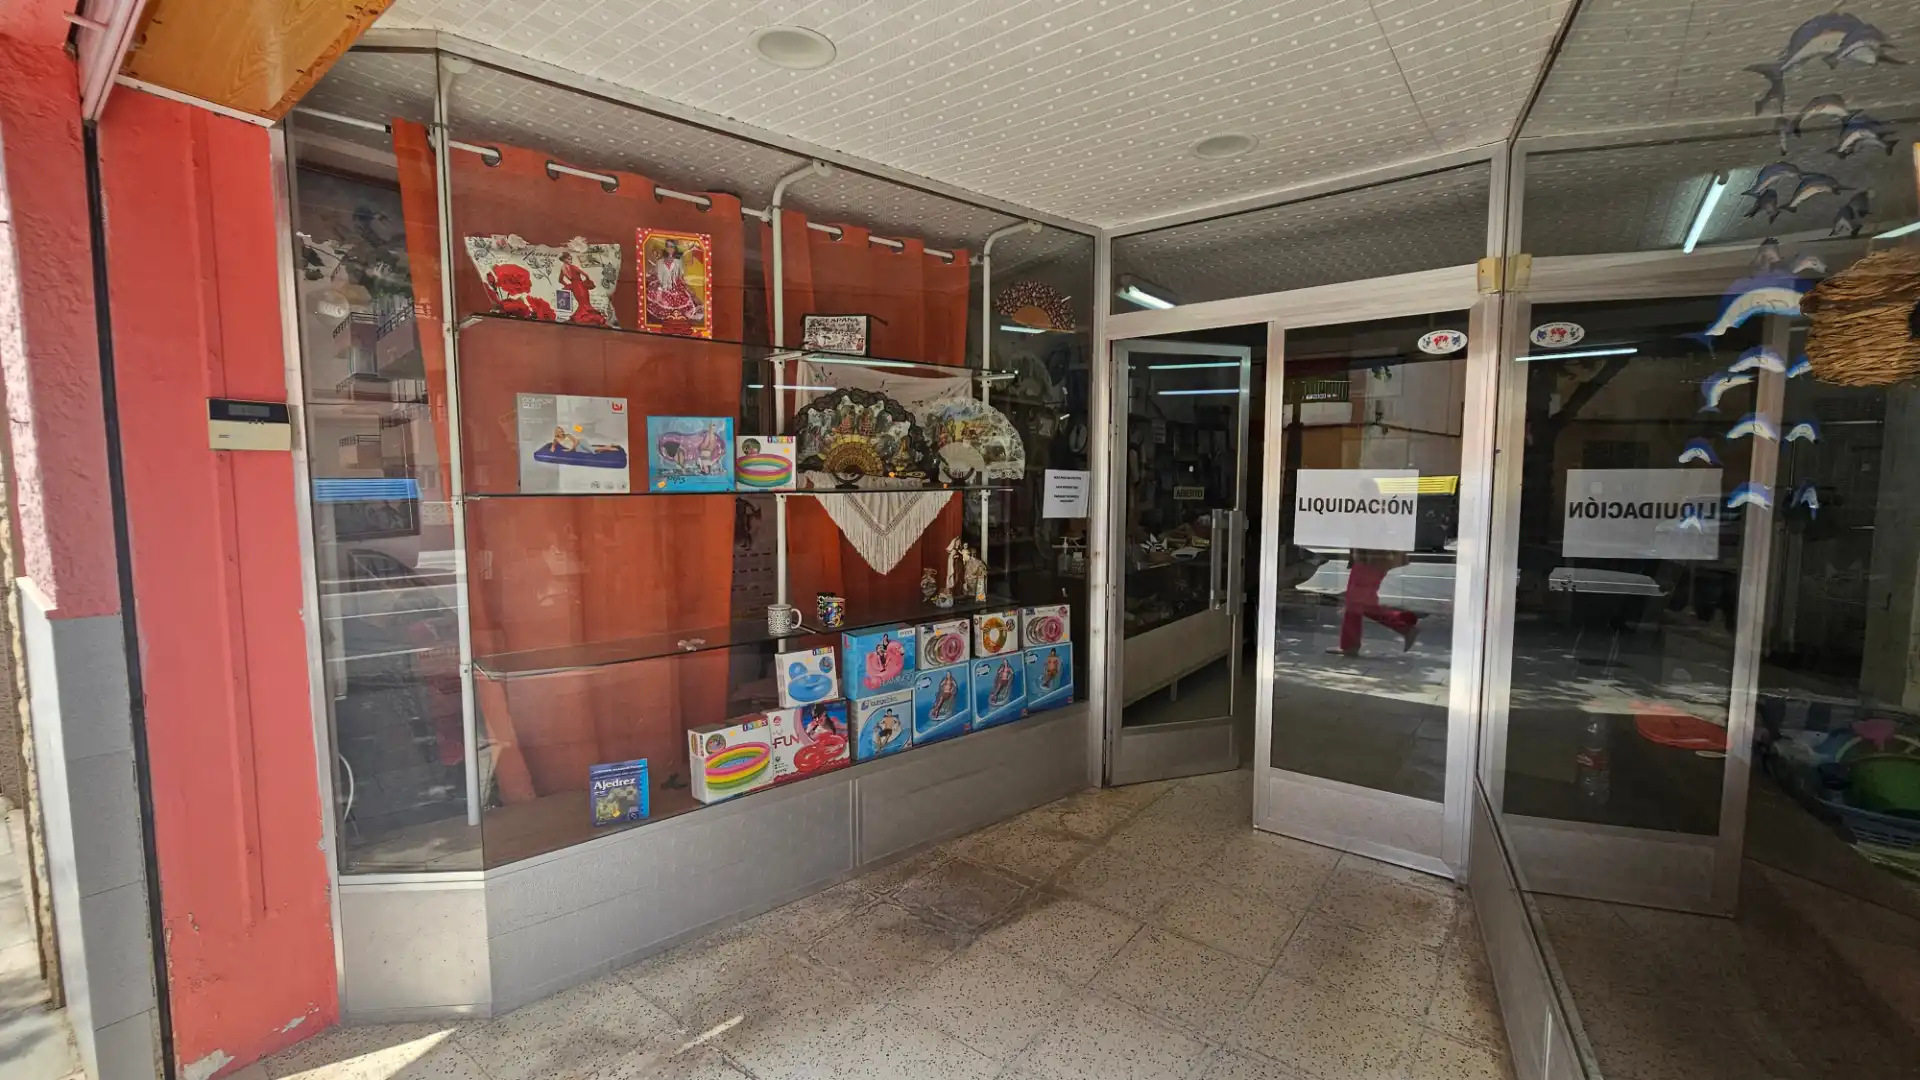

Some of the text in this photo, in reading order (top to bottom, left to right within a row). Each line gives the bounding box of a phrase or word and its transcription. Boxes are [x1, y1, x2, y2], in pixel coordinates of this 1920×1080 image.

[1298, 495, 1413, 515] LIQUIDACIÓN
[772, 734, 800, 749] FUN
[593, 777, 636, 790] Ajedrez
